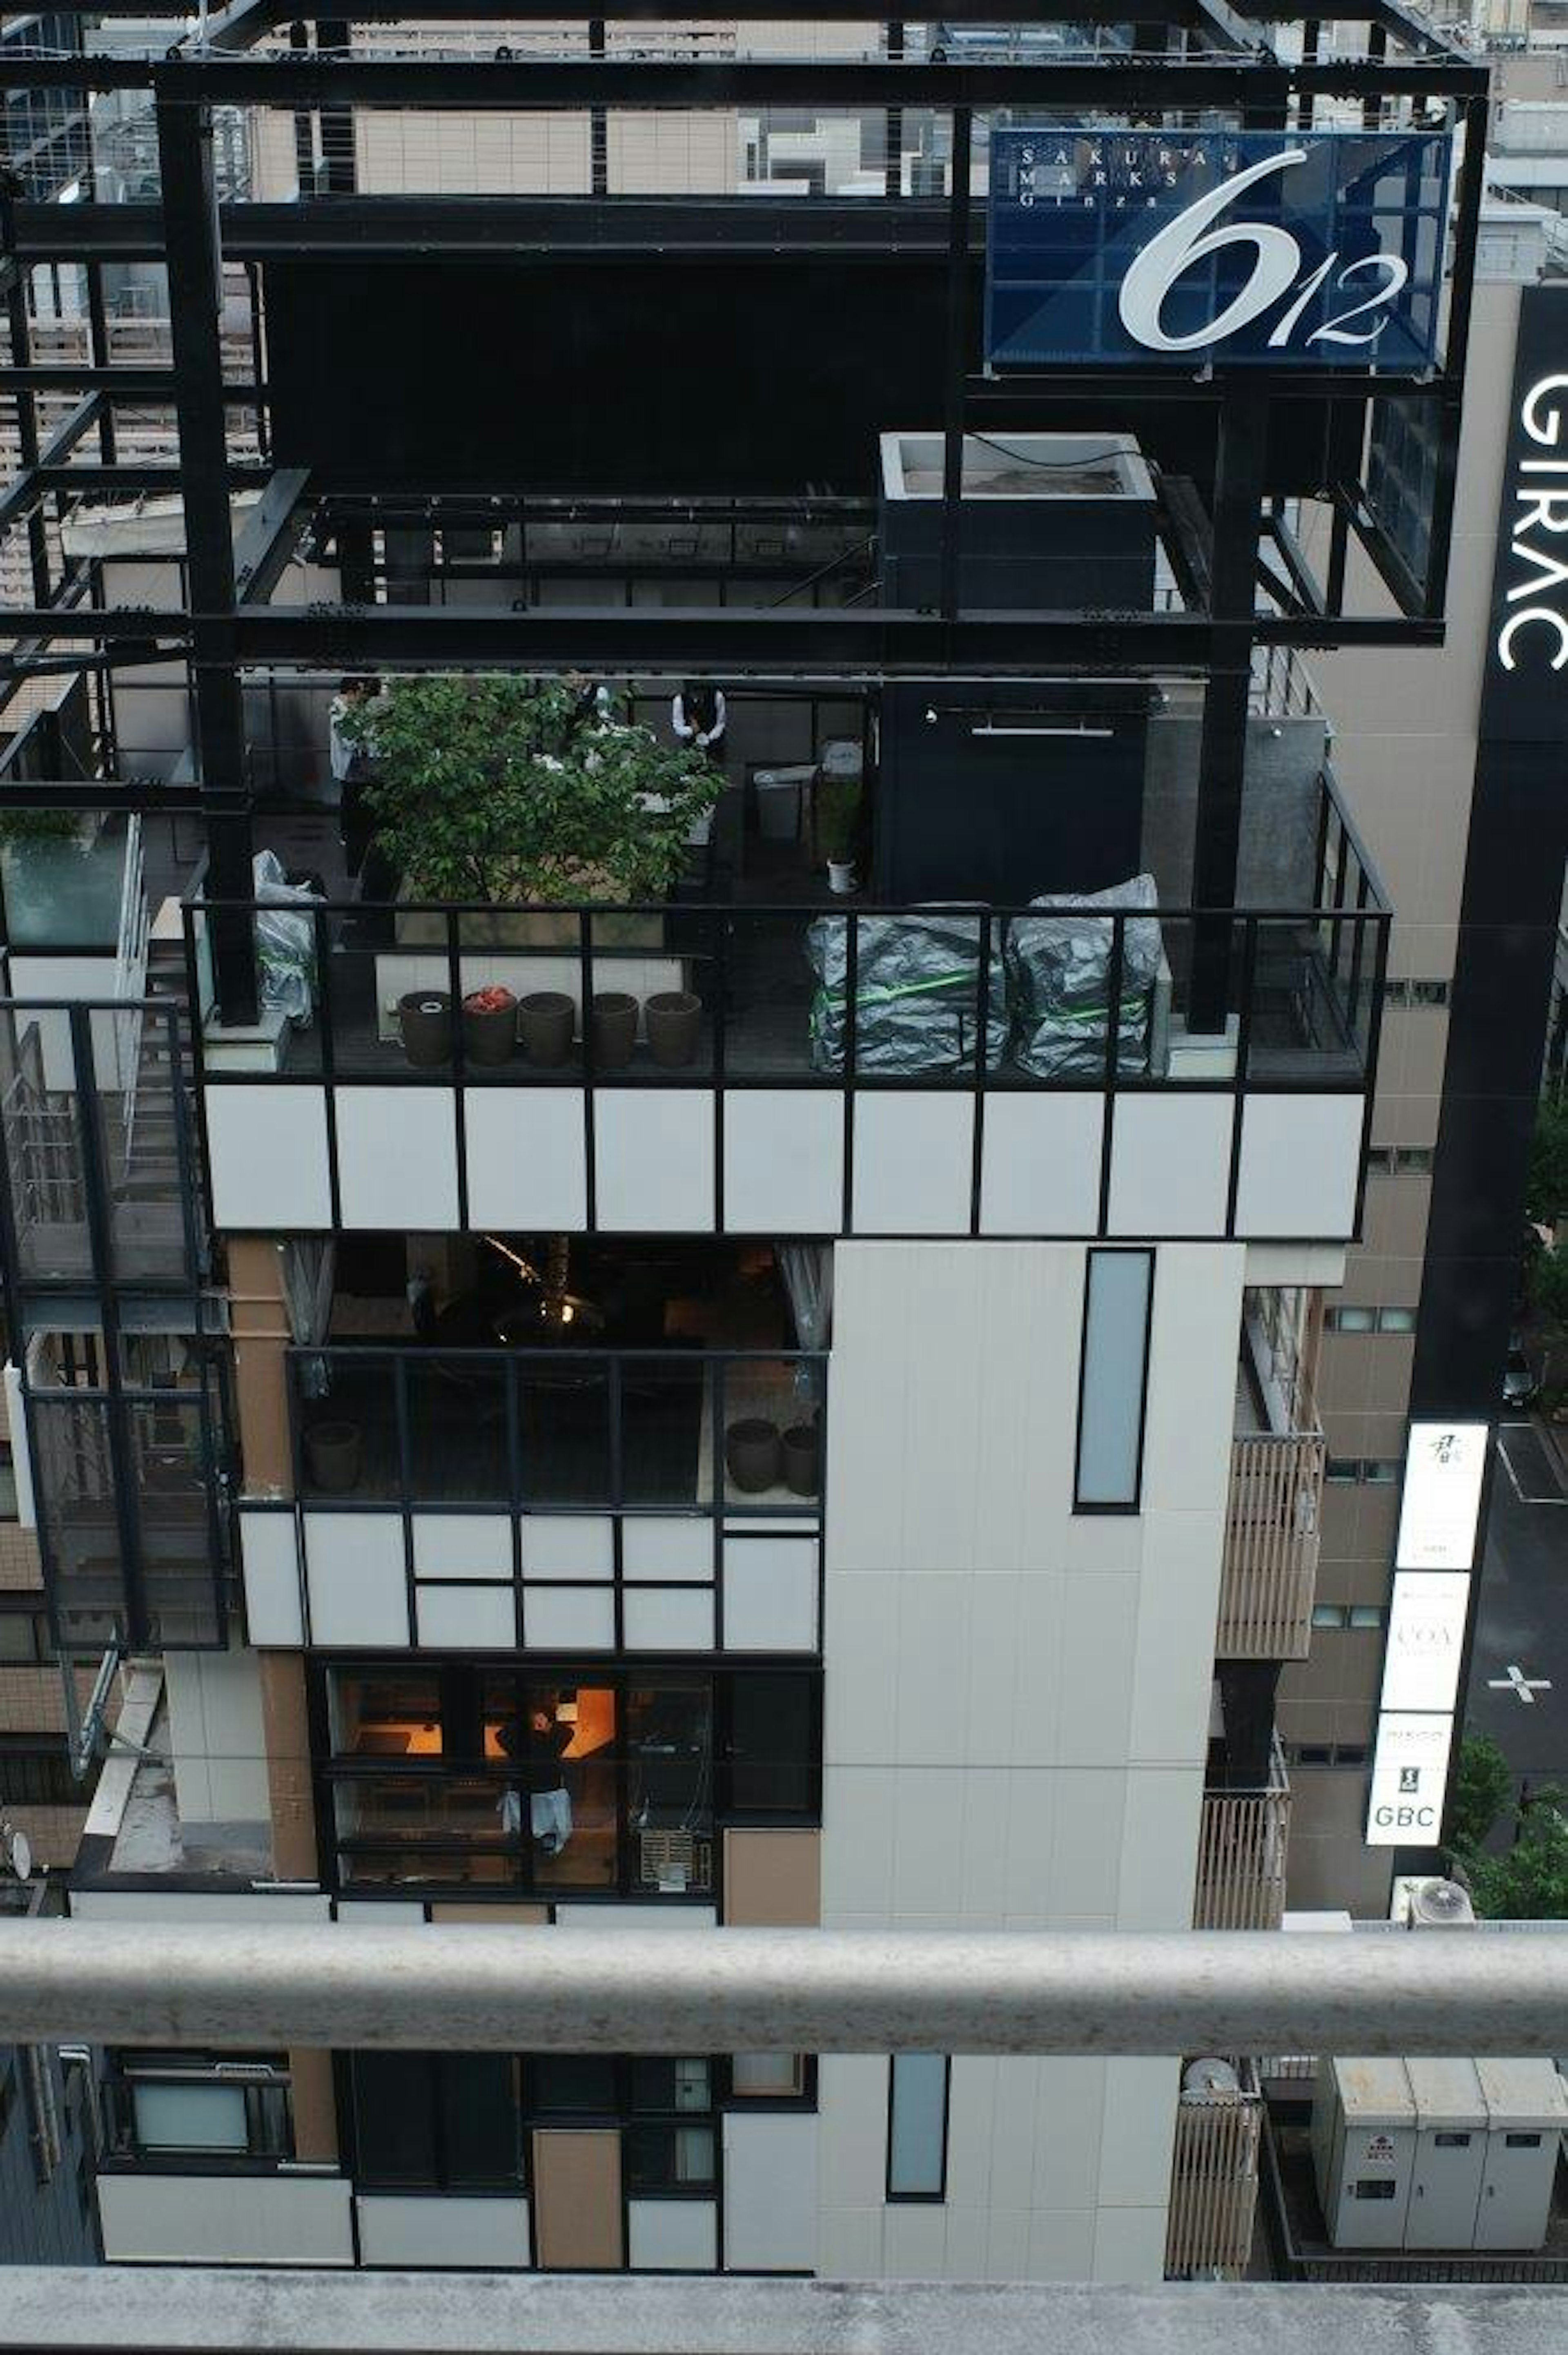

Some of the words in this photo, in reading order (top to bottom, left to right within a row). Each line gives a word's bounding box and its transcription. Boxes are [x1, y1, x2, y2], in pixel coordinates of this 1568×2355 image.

[1021, 148, 1206, 165] SAKURA
[1019, 171, 1178, 188] MARKS
[1020, 190, 1156, 208] Ginza
[1375, 1806, 1435, 1826] GBC
